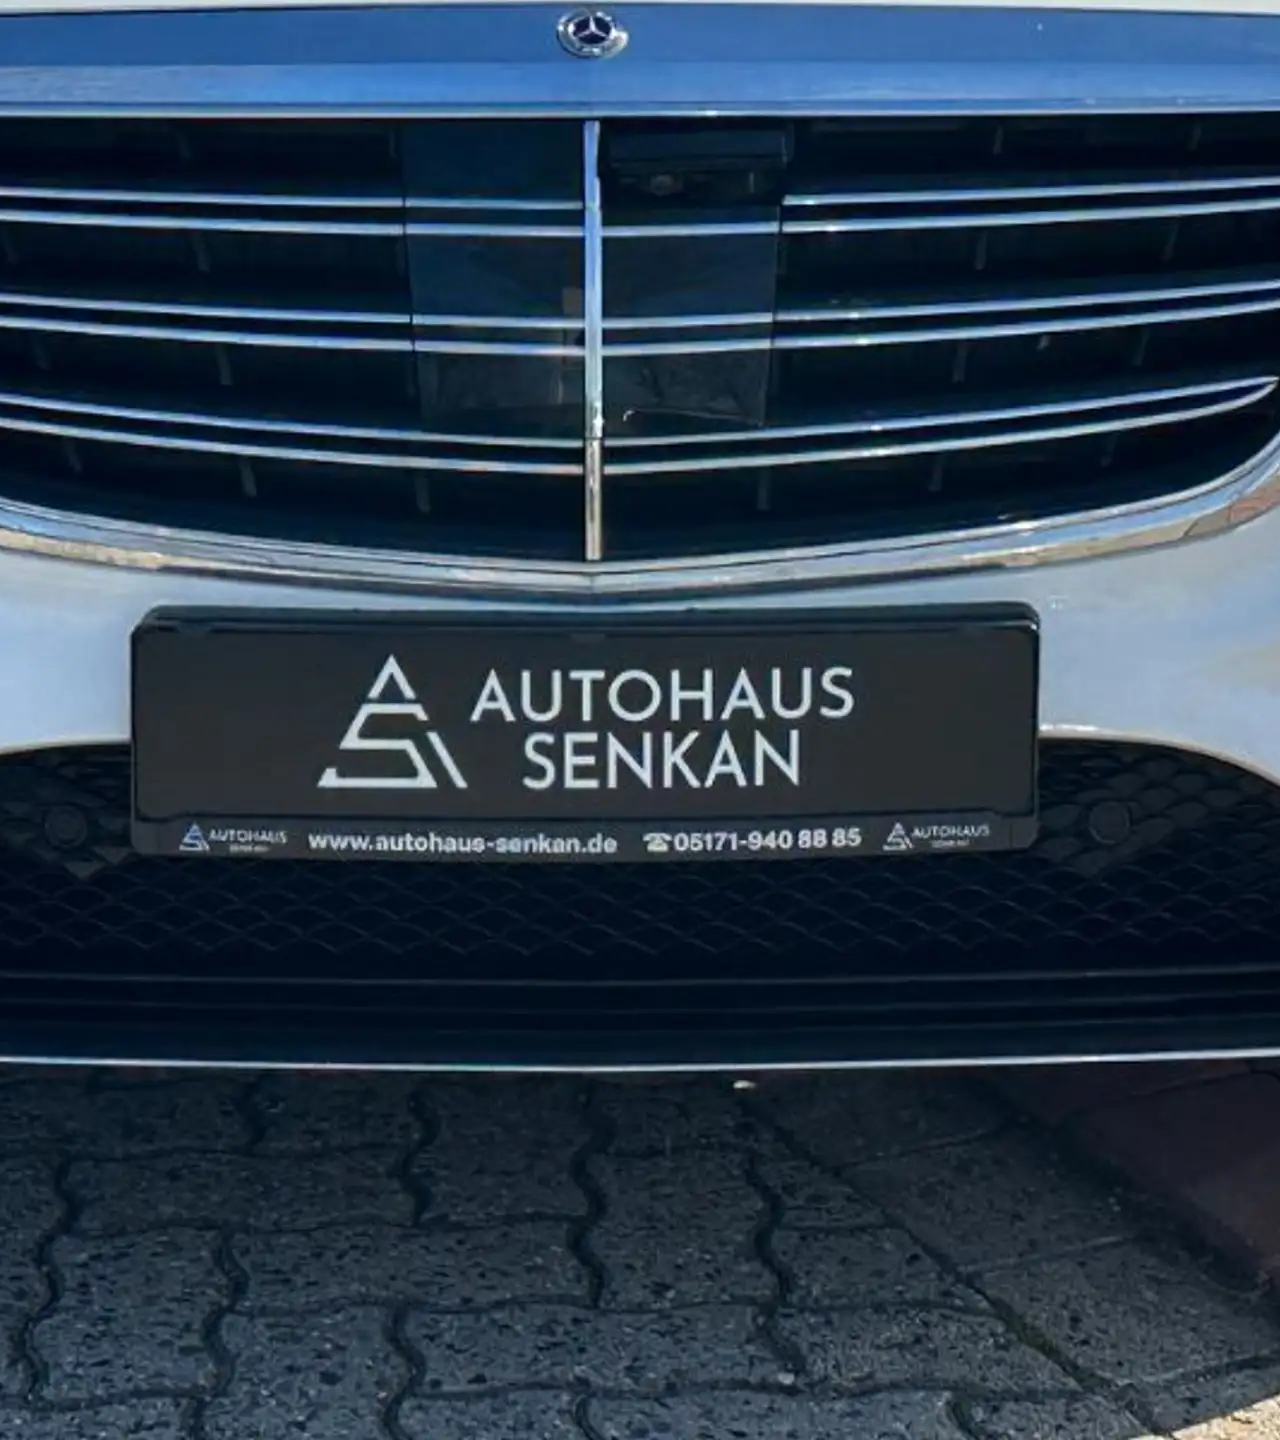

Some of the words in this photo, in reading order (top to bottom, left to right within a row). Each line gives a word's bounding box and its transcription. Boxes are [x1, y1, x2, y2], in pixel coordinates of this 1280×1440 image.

[470, 666, 855, 723] AUTOHAUS
[523, 729, 800, 791] SENKAN
[208, 828, 288, 844] AUTOHAUS
[307, 831, 619, 855] www.autohaus-senkan.de
[831, 827, 863, 848] 85
